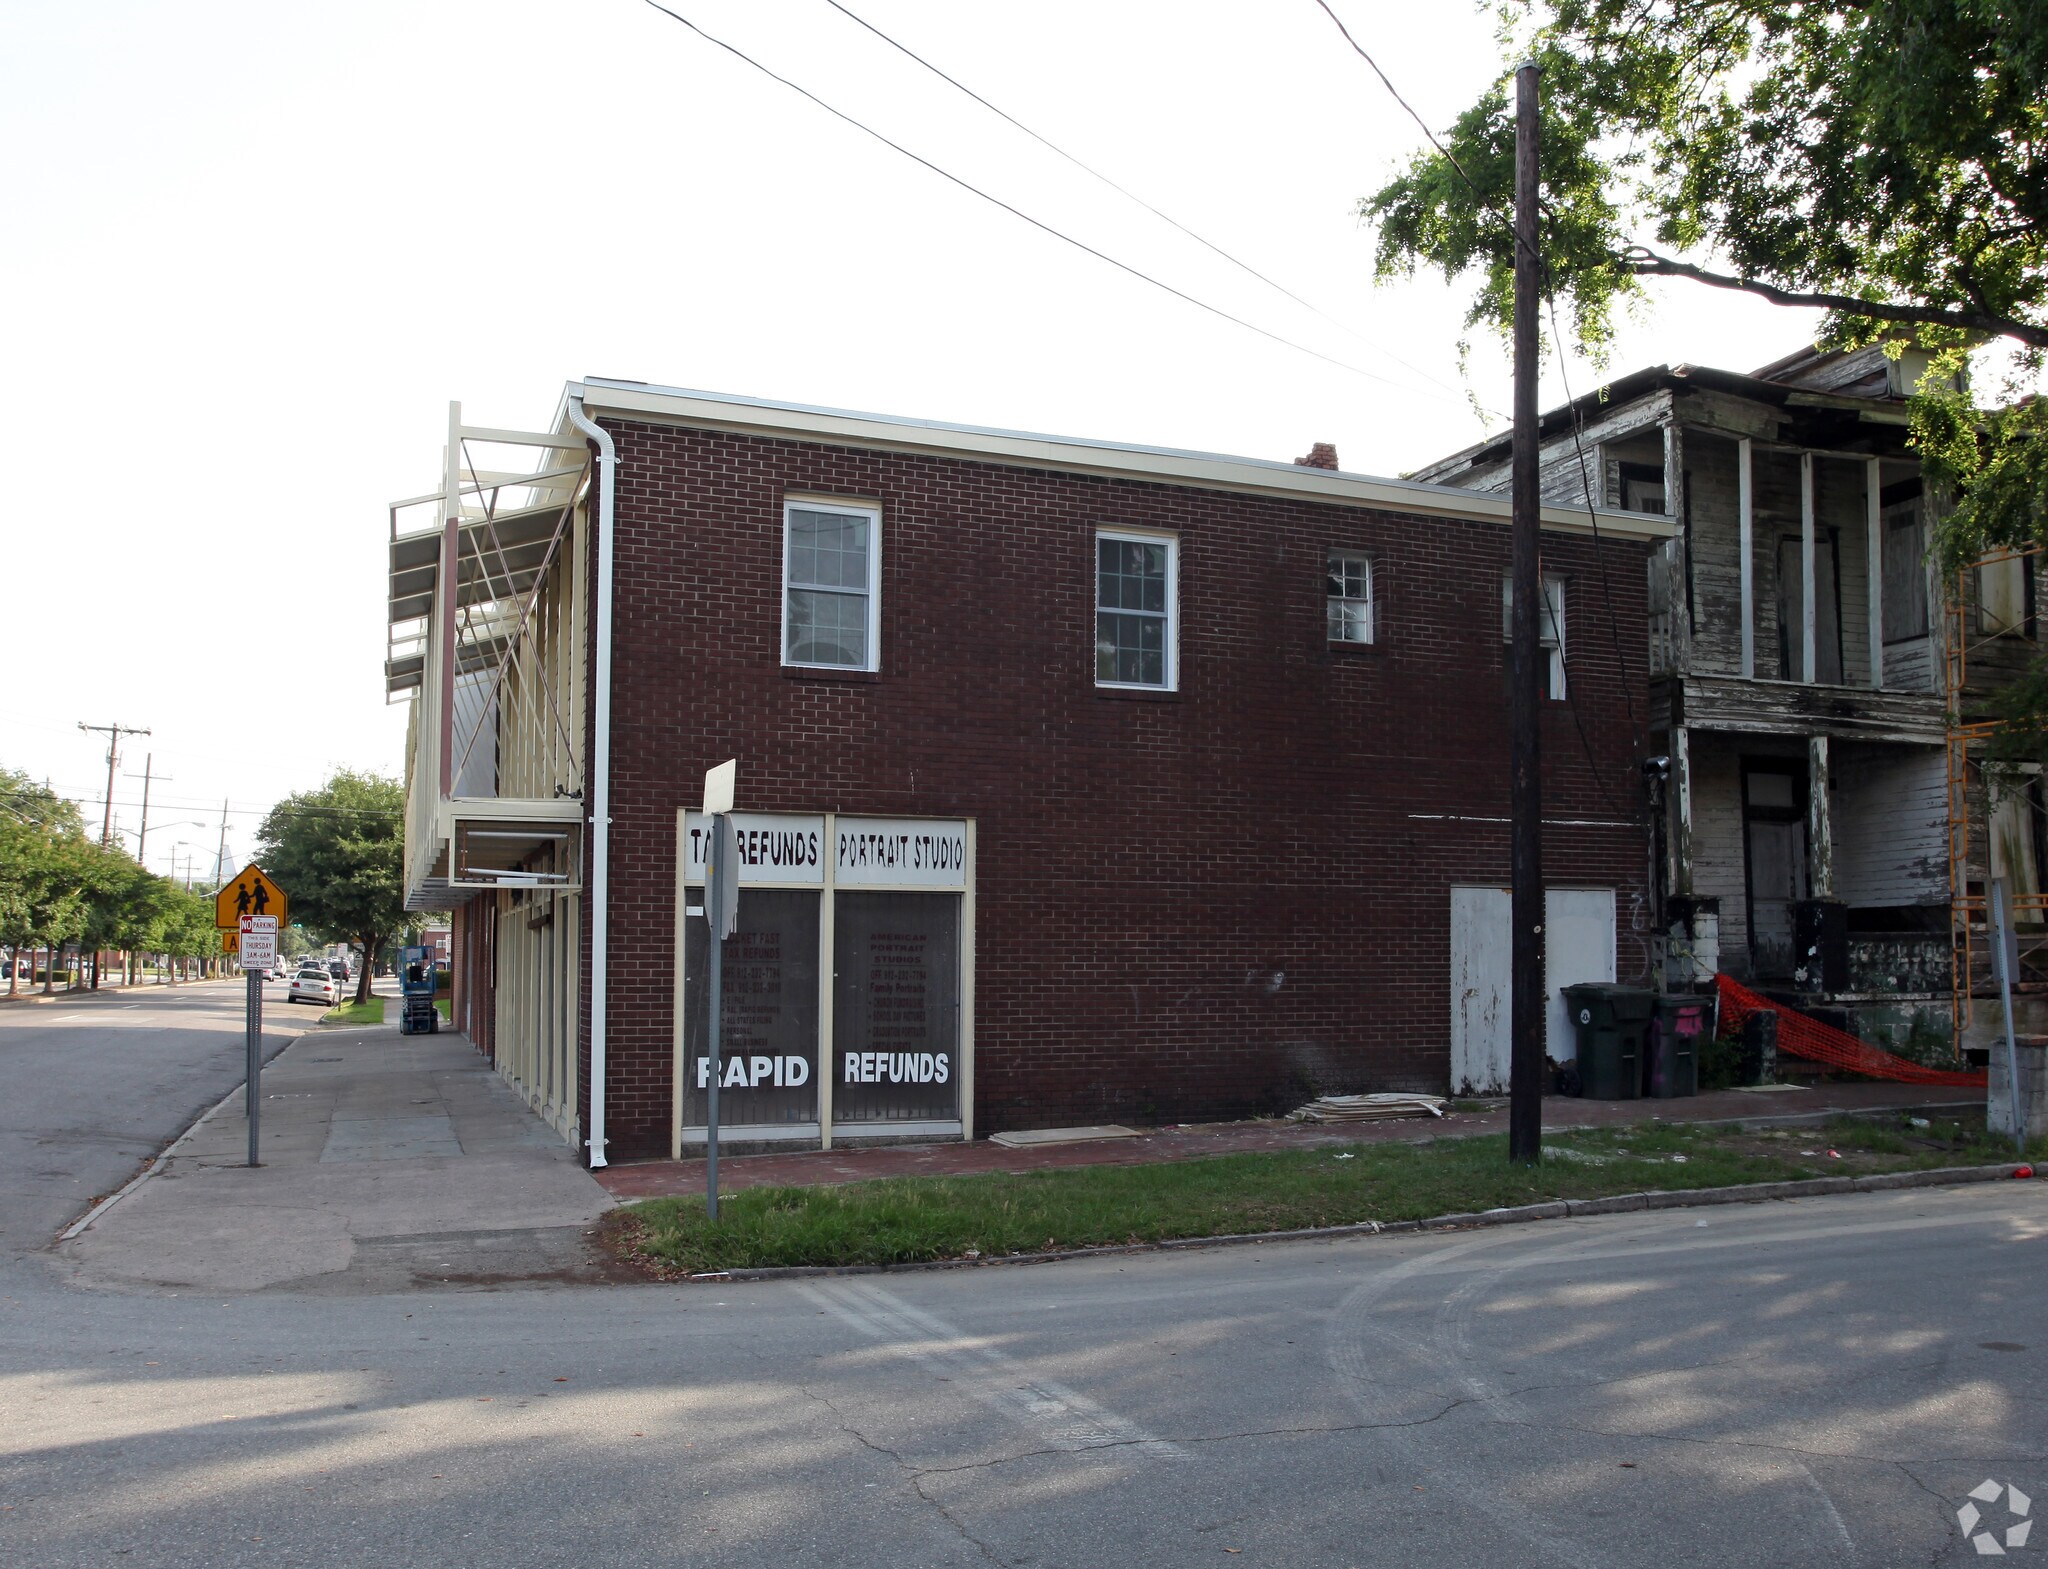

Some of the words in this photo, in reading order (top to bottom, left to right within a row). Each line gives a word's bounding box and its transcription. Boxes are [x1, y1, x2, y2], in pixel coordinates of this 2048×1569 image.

[736, 830, 818, 866] REFUNDS
[840, 833, 908, 868] PORTRAIT
[914, 835, 963, 870] STUDIO
[241, 919, 252, 930] NO
[253, 921, 275, 930] PARKING
[759, 932, 781, 945] FAST
[870, 933, 928, 941] AMERICAN
[724, 947, 741, 959] TAX
[743, 947, 781, 959] REFUNDS
[870, 944, 926, 952] PORTRAIT
[246, 951, 271, 959] 3AM-6AM
[870, 982, 893, 995] Family
[896, 982, 926, 993] Portraits
[697, 1056, 809, 1088] RAPID
[844, 1052, 949, 1084] REFUNDS
